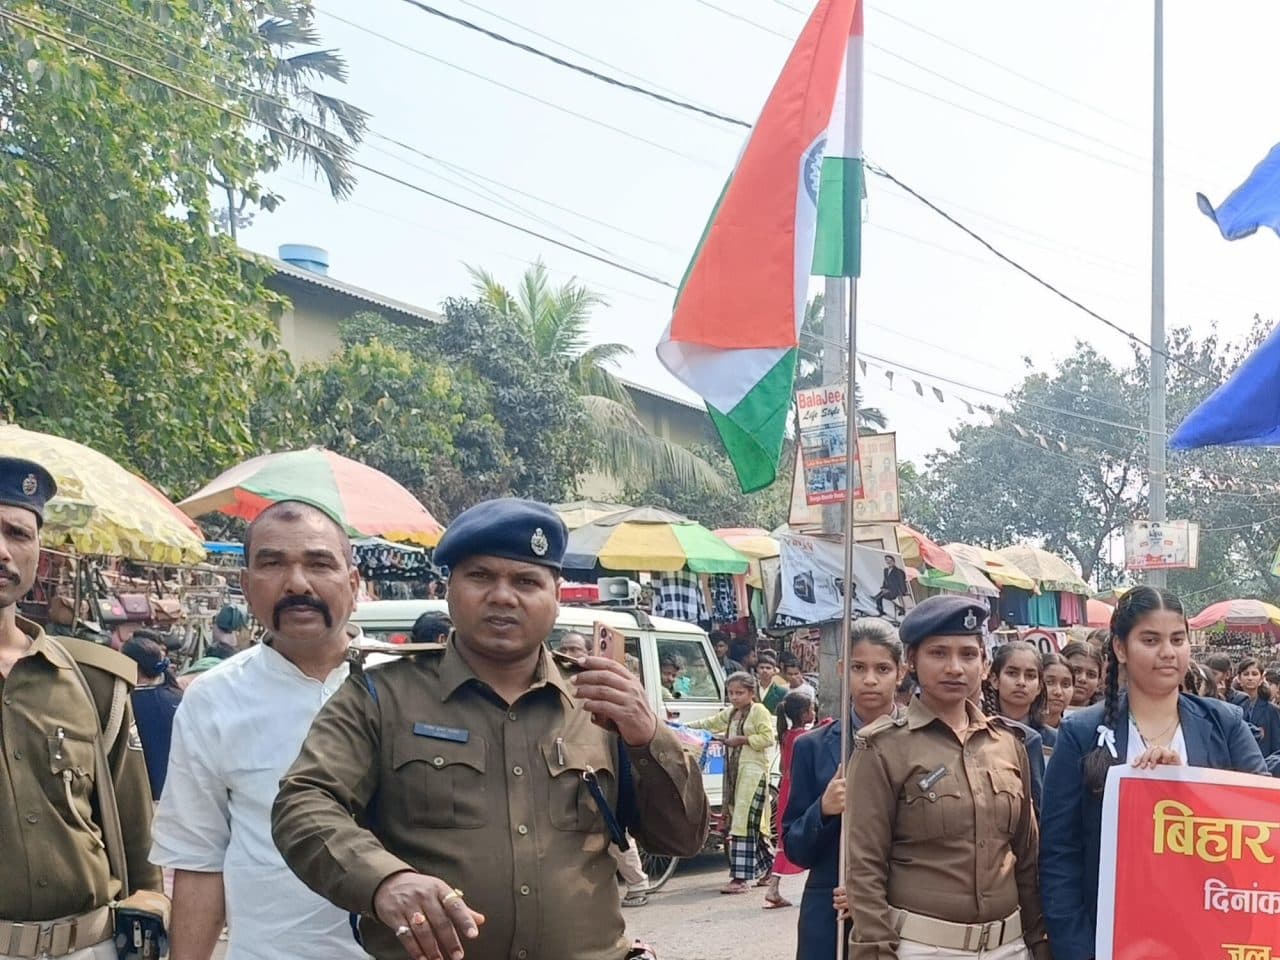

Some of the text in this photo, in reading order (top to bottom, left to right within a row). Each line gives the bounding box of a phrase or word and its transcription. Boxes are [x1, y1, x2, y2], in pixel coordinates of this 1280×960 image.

[799, 389, 841, 409] BalaJee
[821, 406, 840, 417] Style
[1153, 799, 1280, 864] बिहार
